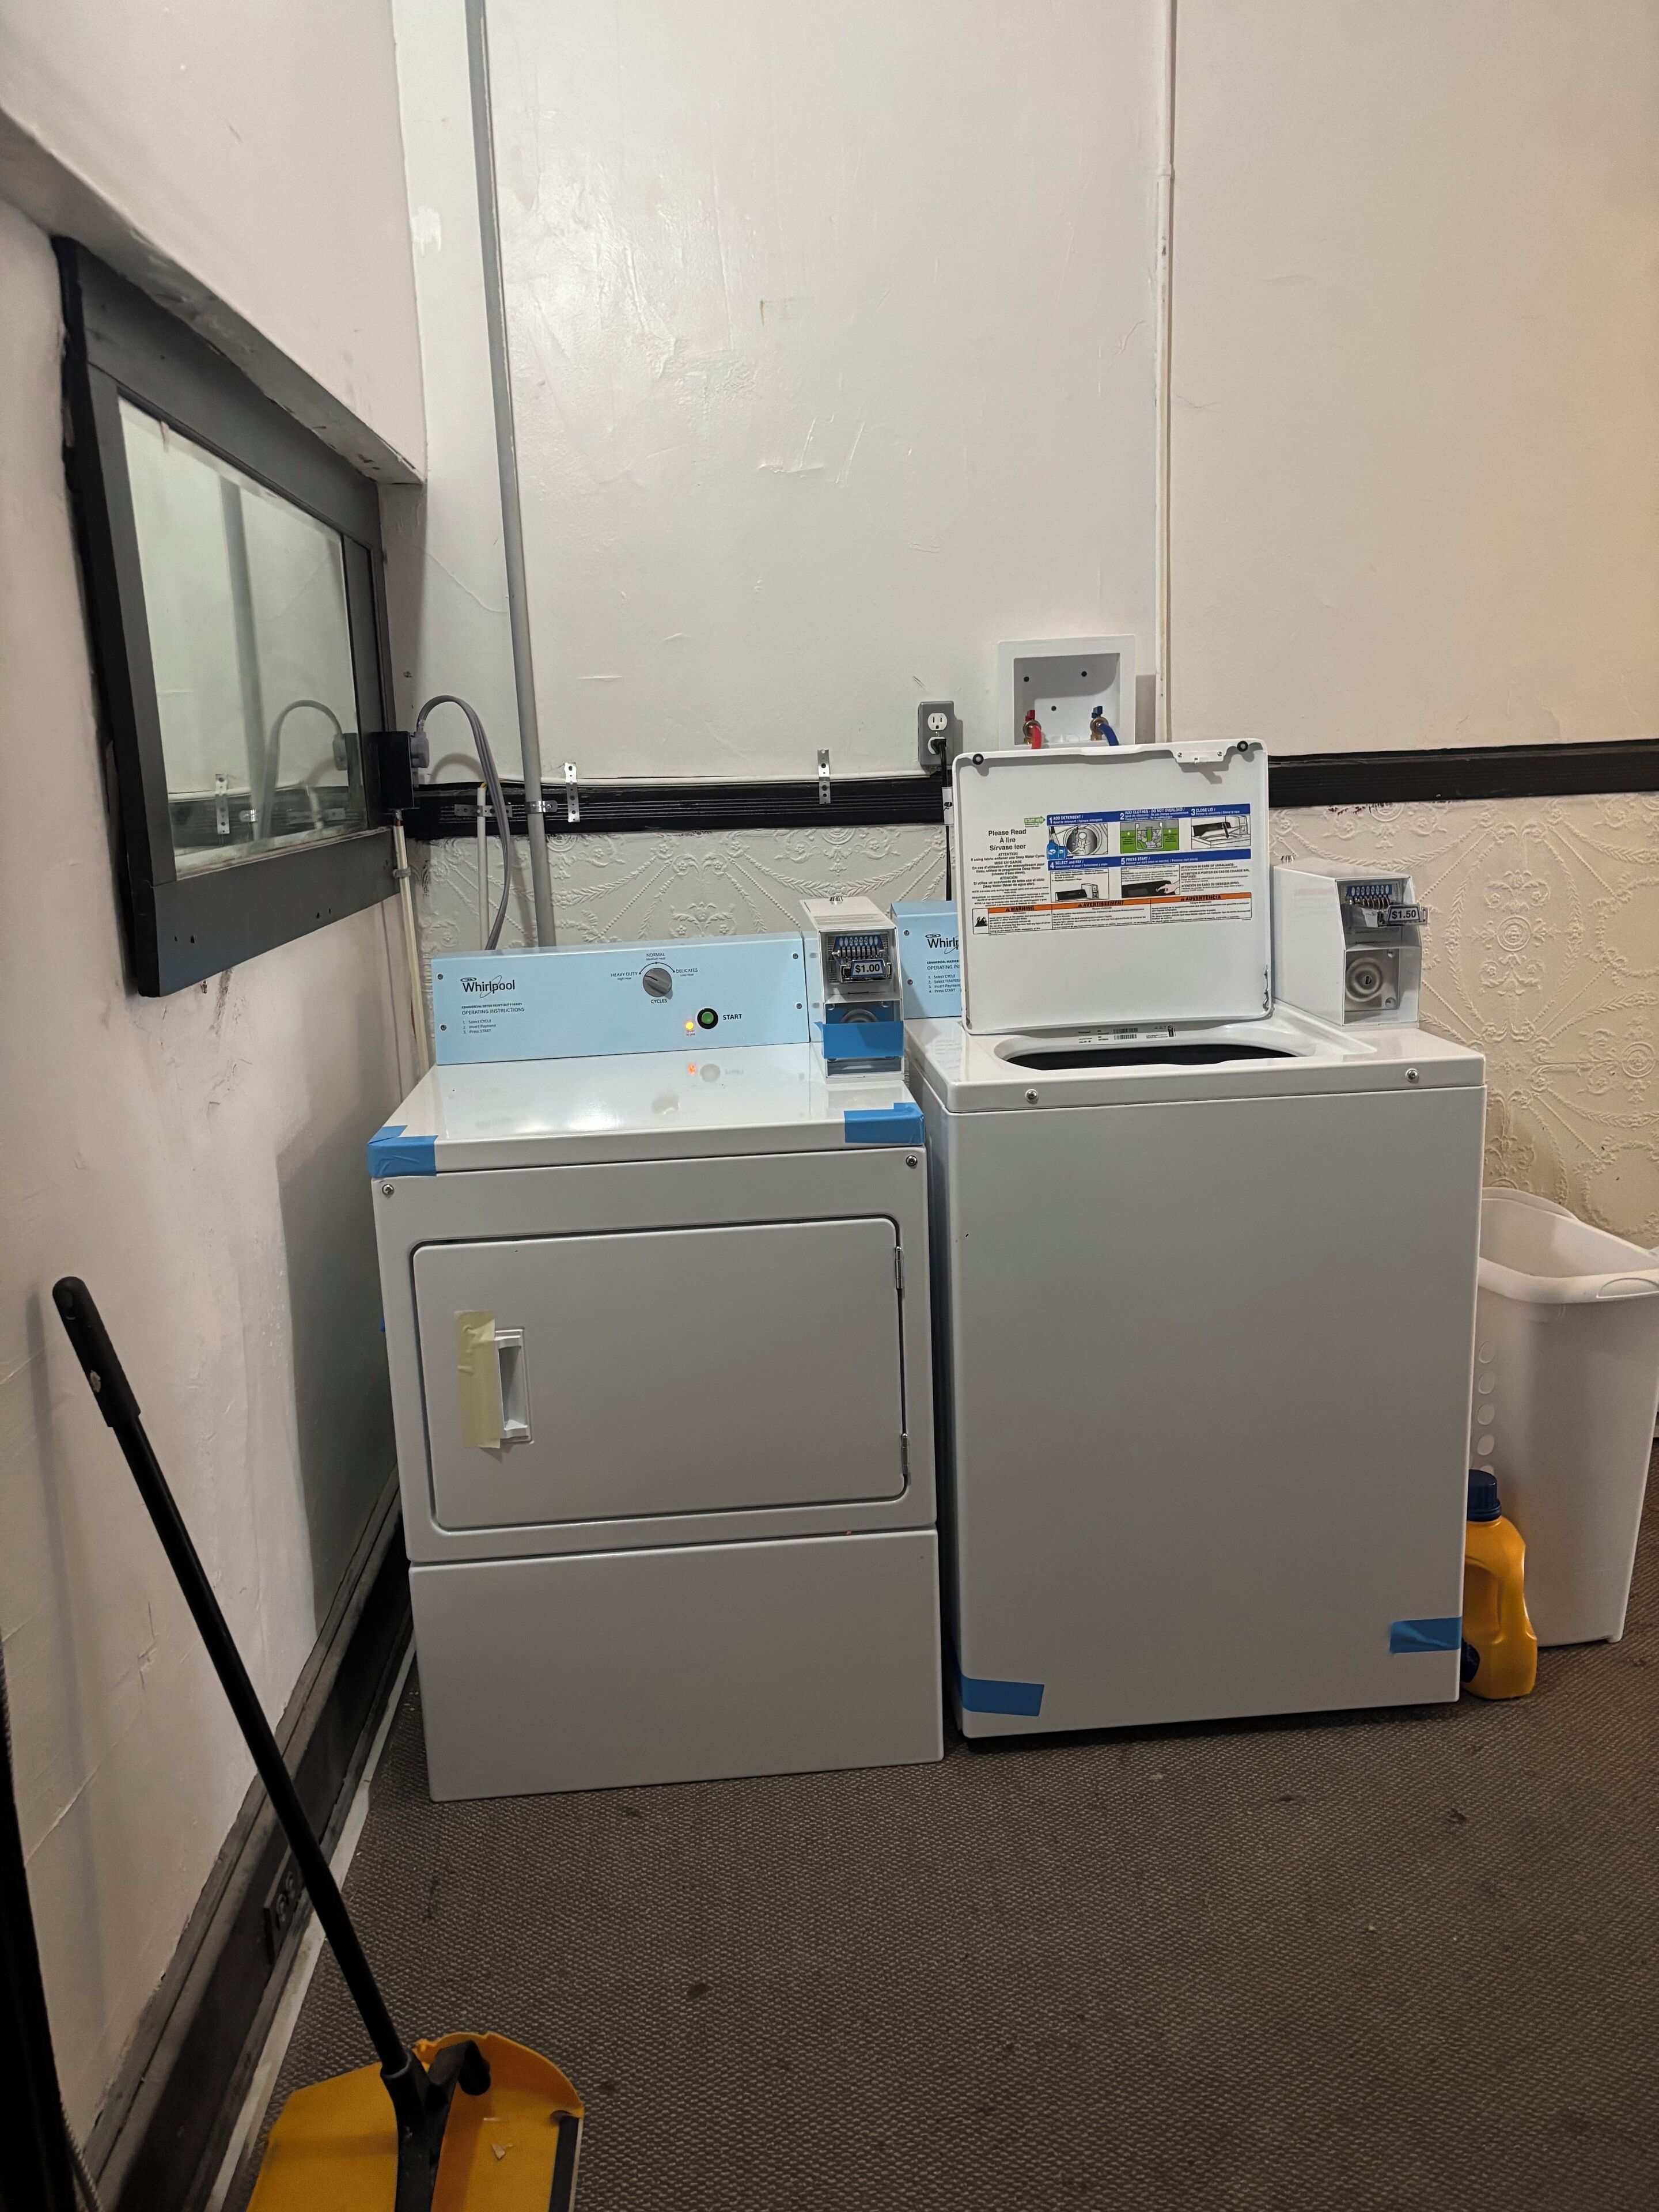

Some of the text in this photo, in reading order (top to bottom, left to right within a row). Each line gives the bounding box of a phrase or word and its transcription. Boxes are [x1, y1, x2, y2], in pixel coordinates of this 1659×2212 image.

[1049, 816, 1052, 824] 1
[1392, 910, 1416, 919] $1.50
[855, 963, 880, 973] $1.00
[462, 979, 516, 994] Whirlpool
